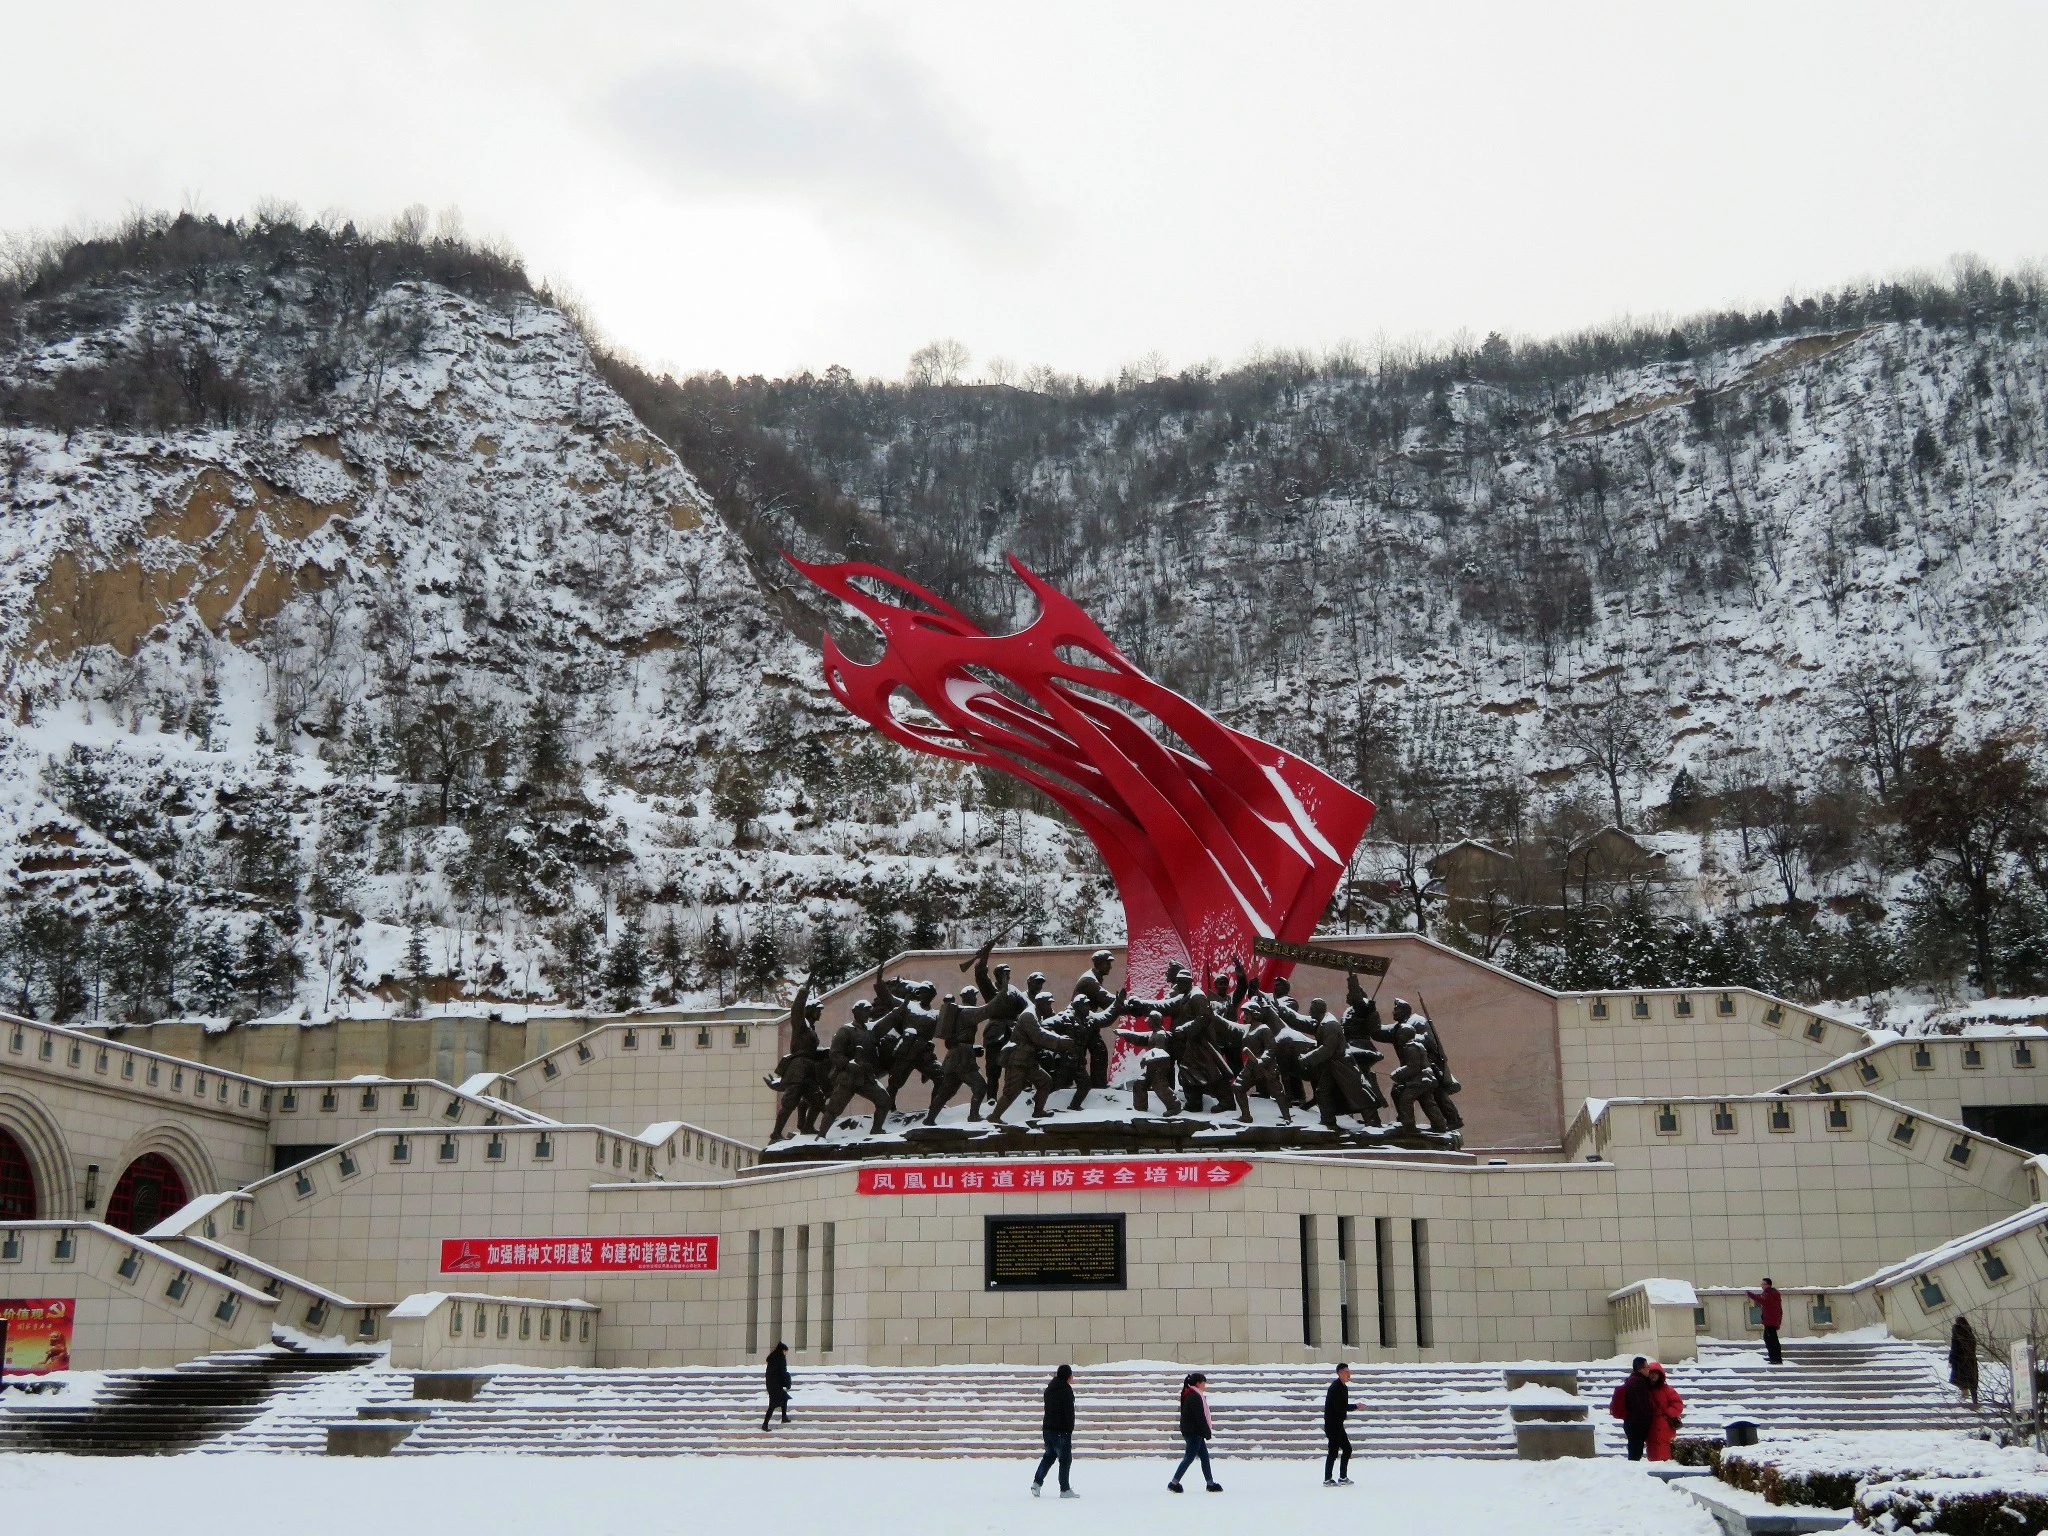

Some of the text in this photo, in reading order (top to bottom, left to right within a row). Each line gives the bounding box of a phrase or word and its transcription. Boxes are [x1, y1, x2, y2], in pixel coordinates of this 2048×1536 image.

[873, 1166, 1230, 1189] 凤凰山街道消防安全培训会
[487, 1242, 707, 1264] 加强精神文明建设 构建和谐稳定社区
[0, 1308, 43, 1320] 价值观
